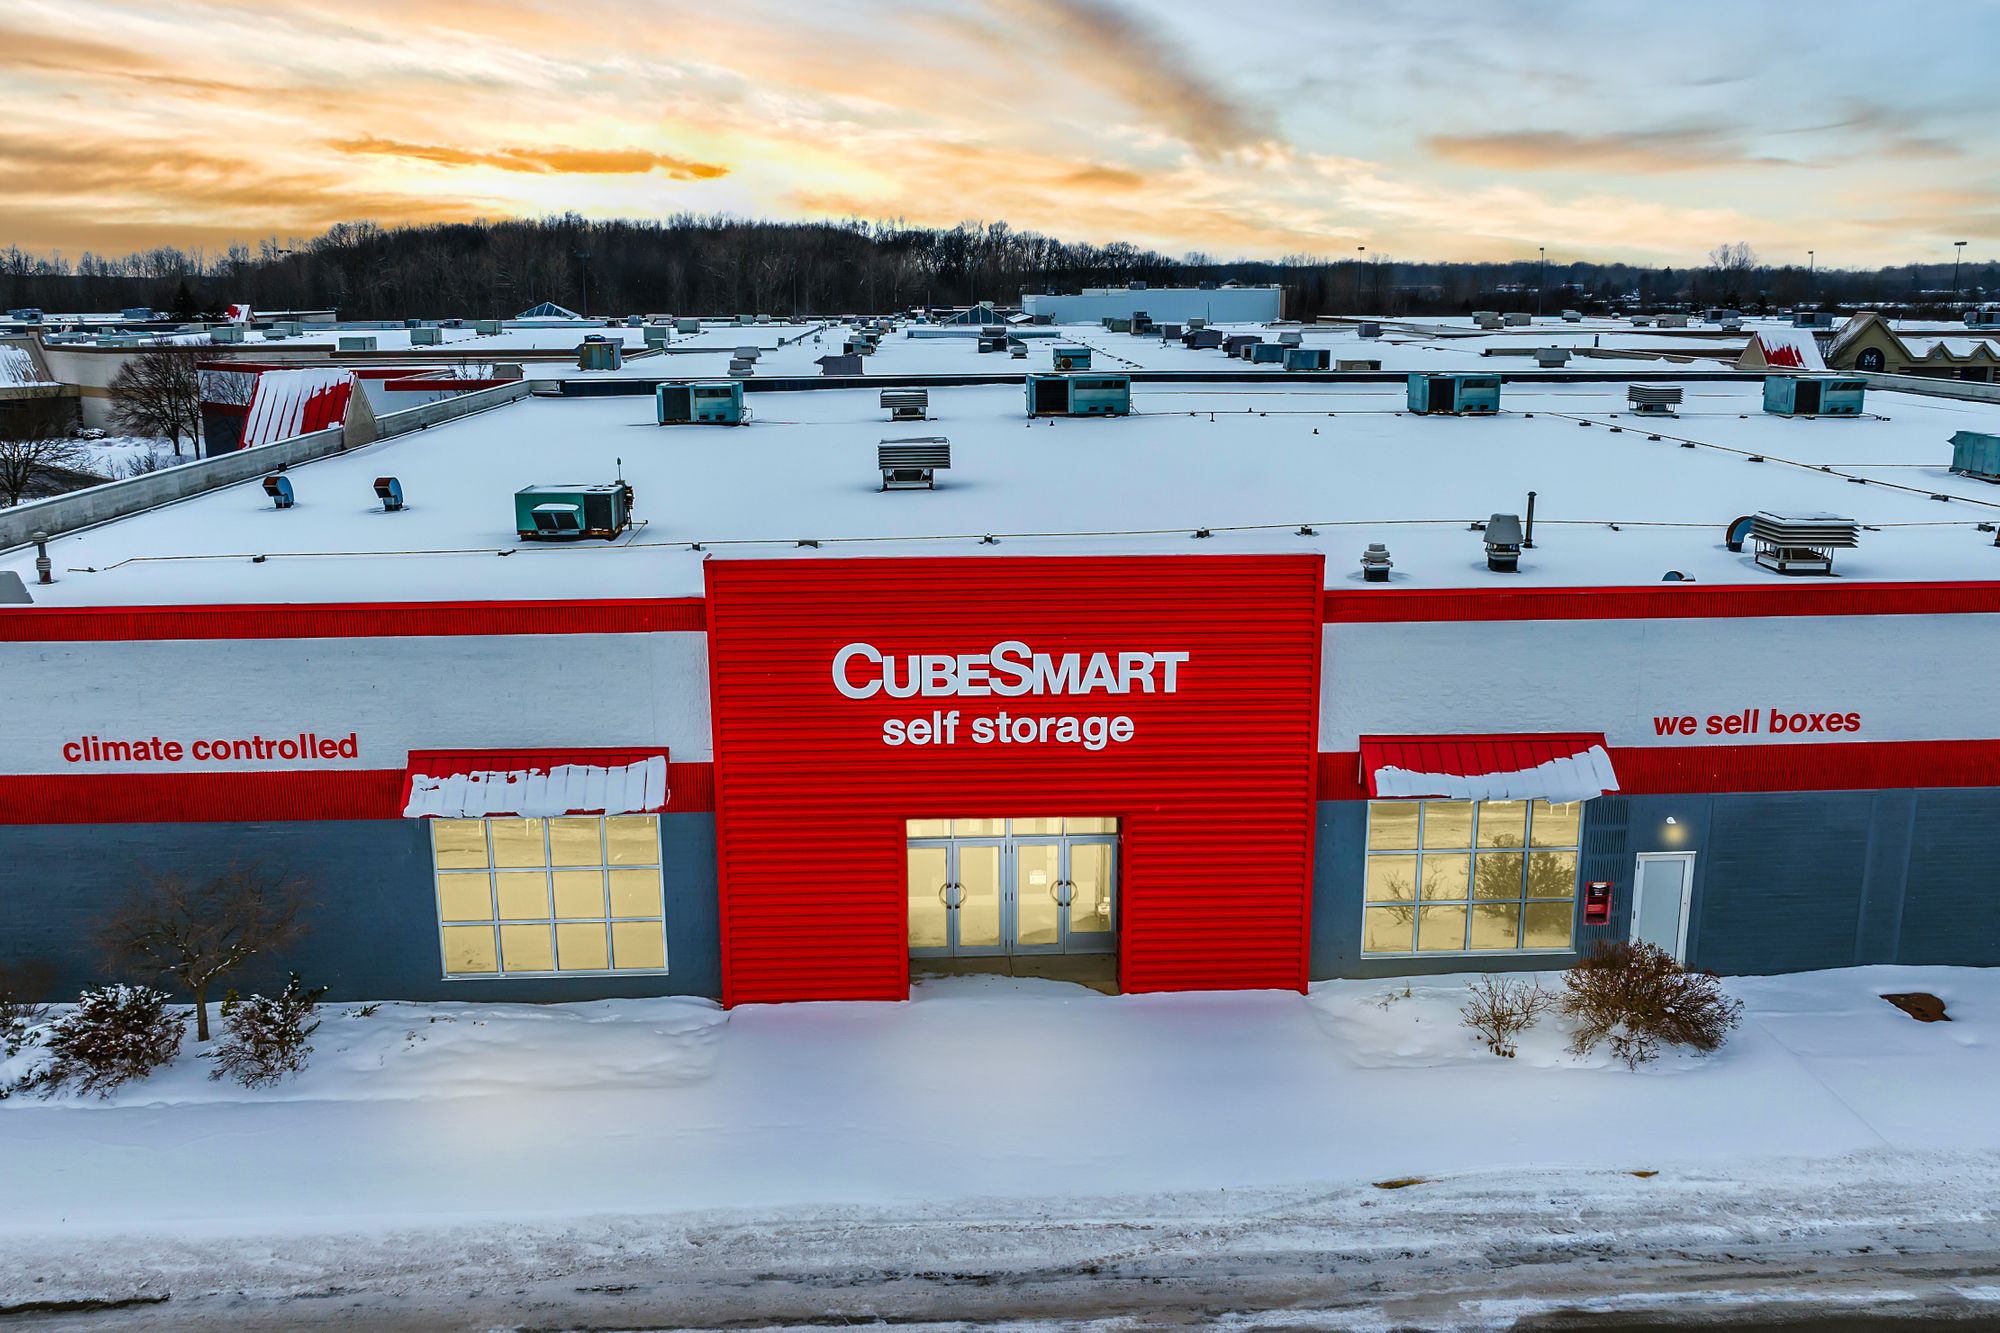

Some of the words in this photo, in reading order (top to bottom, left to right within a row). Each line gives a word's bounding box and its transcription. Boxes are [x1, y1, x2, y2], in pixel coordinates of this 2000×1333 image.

[882, 710, 960, 746] self
[971, 711, 1135, 751] storage
[1653, 716, 1698, 737] we
[1706, 709, 1761, 735] sell
[1769, 708, 1861, 734] boxes
[63, 735, 183, 763] climate
[191, 732, 359, 761] controlled
